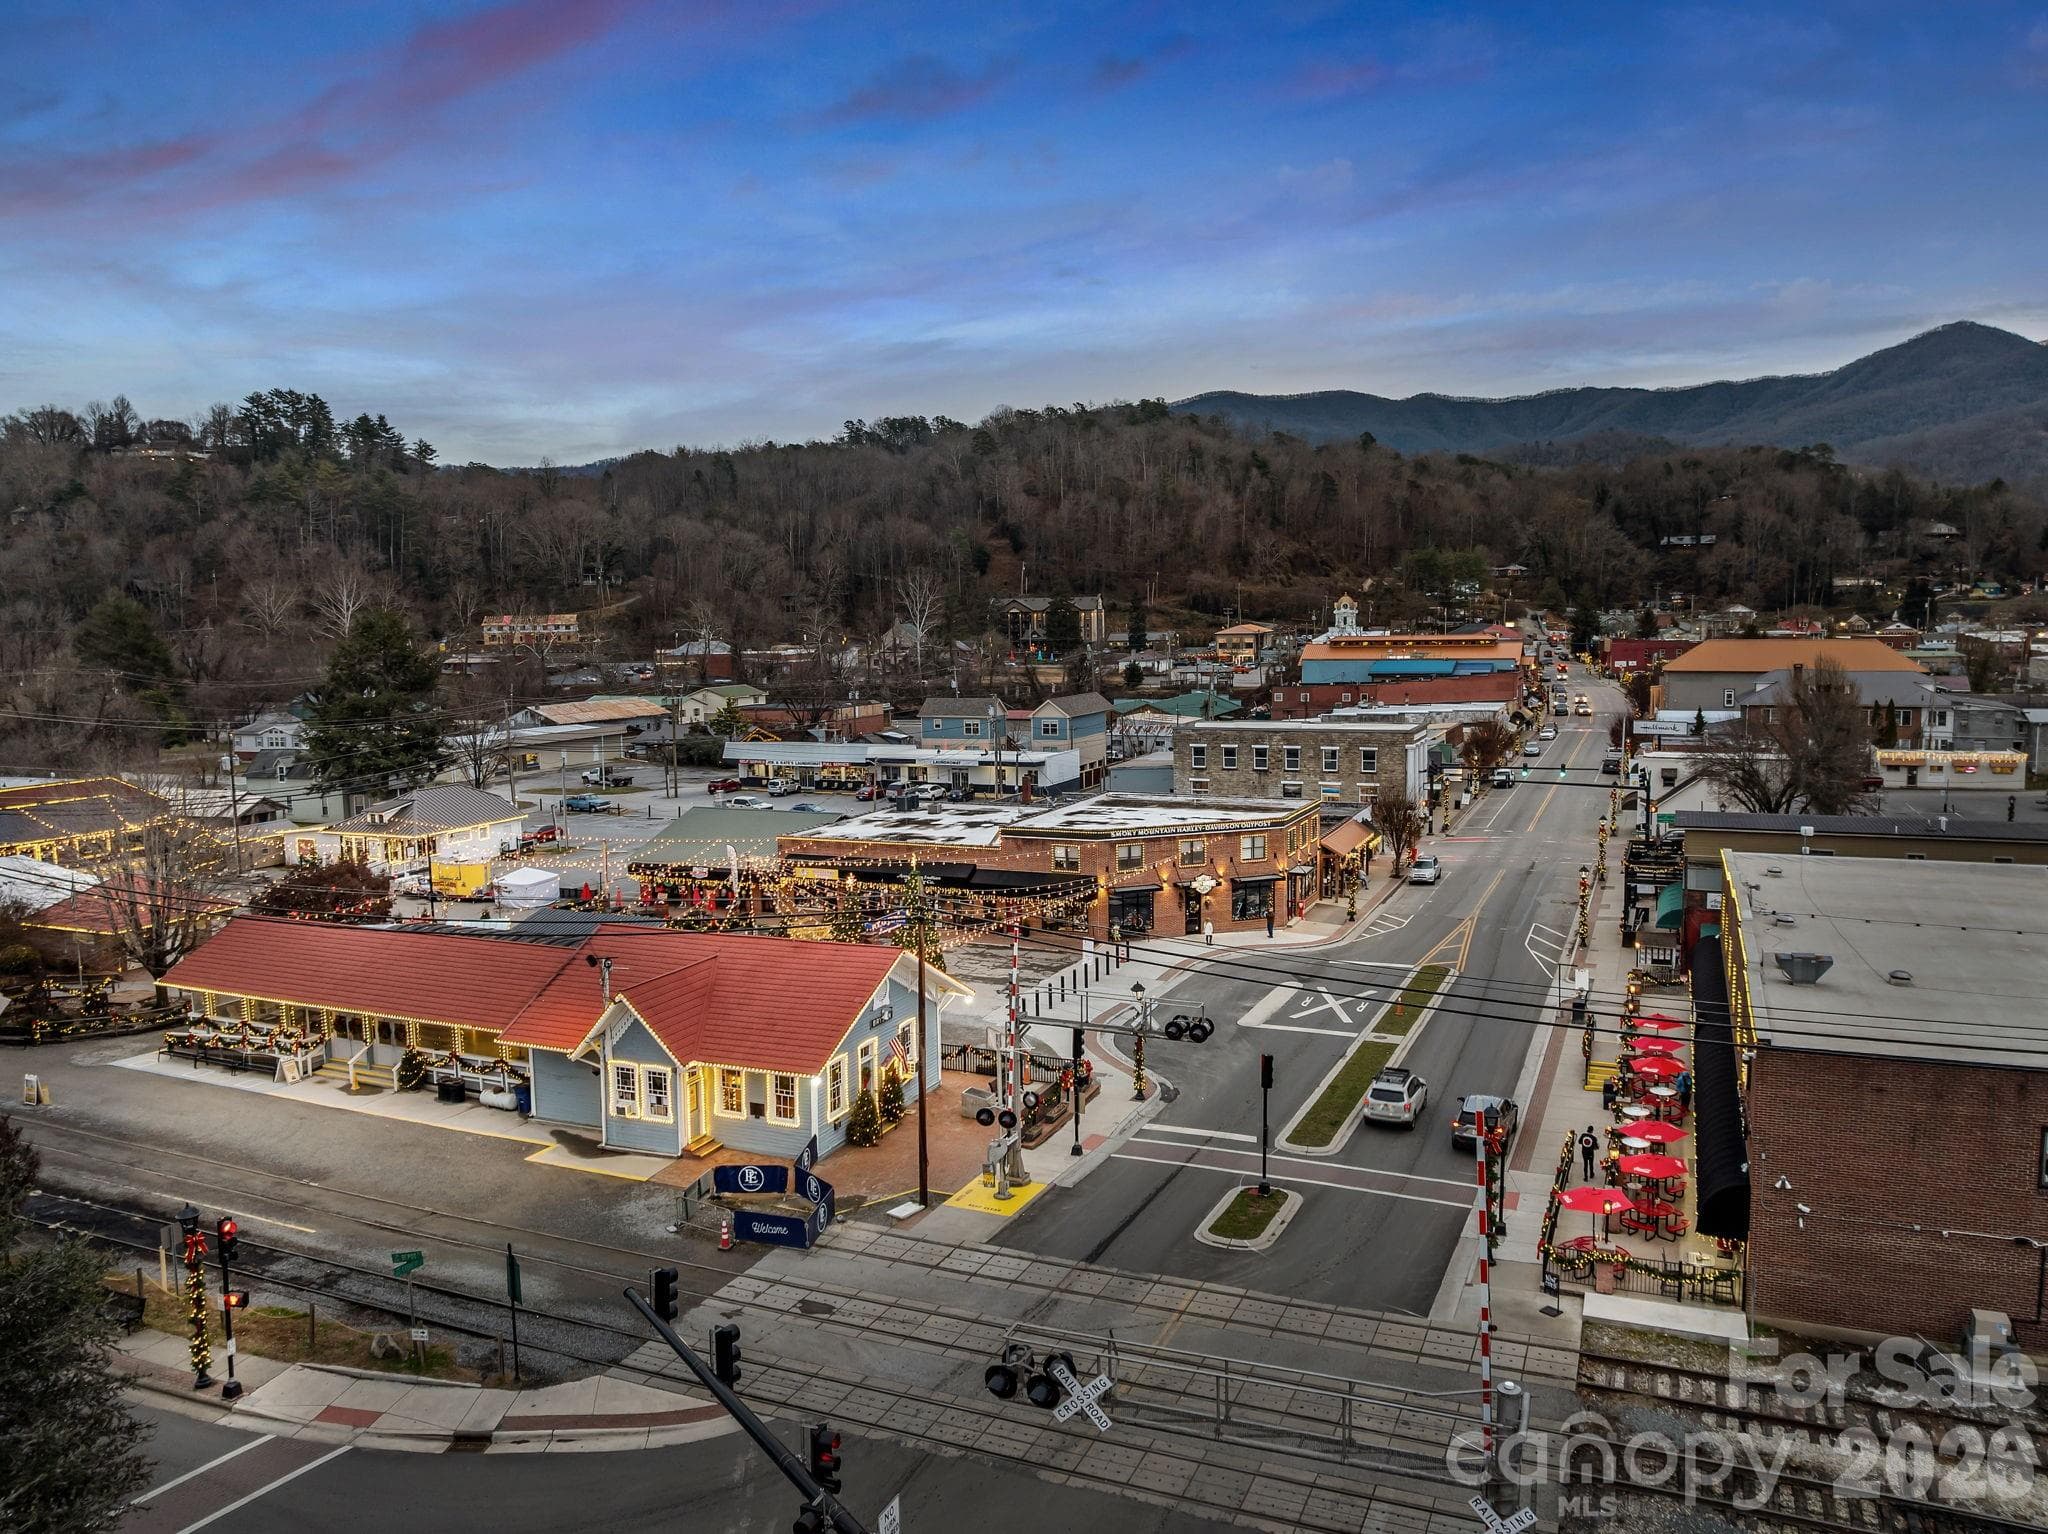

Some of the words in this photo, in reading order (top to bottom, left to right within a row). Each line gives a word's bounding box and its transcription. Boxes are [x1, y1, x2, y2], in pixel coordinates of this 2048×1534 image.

[1110, 829, 1137, 838] SMOKY
[1138, 825, 1178, 836] MOUNTAIN
[1241, 820, 1271, 830] OUTPOST
[751, 1221, 789, 1235] Welcome
[1056, 1368, 1077, 1393] RAIL
[1085, 1402, 1109, 1429] ROAD
[1057, 1378, 1107, 1418] CROSSING
[884, 1505, 895, 1522] NO
[1471, 1497, 1497, 1528] RAIL
